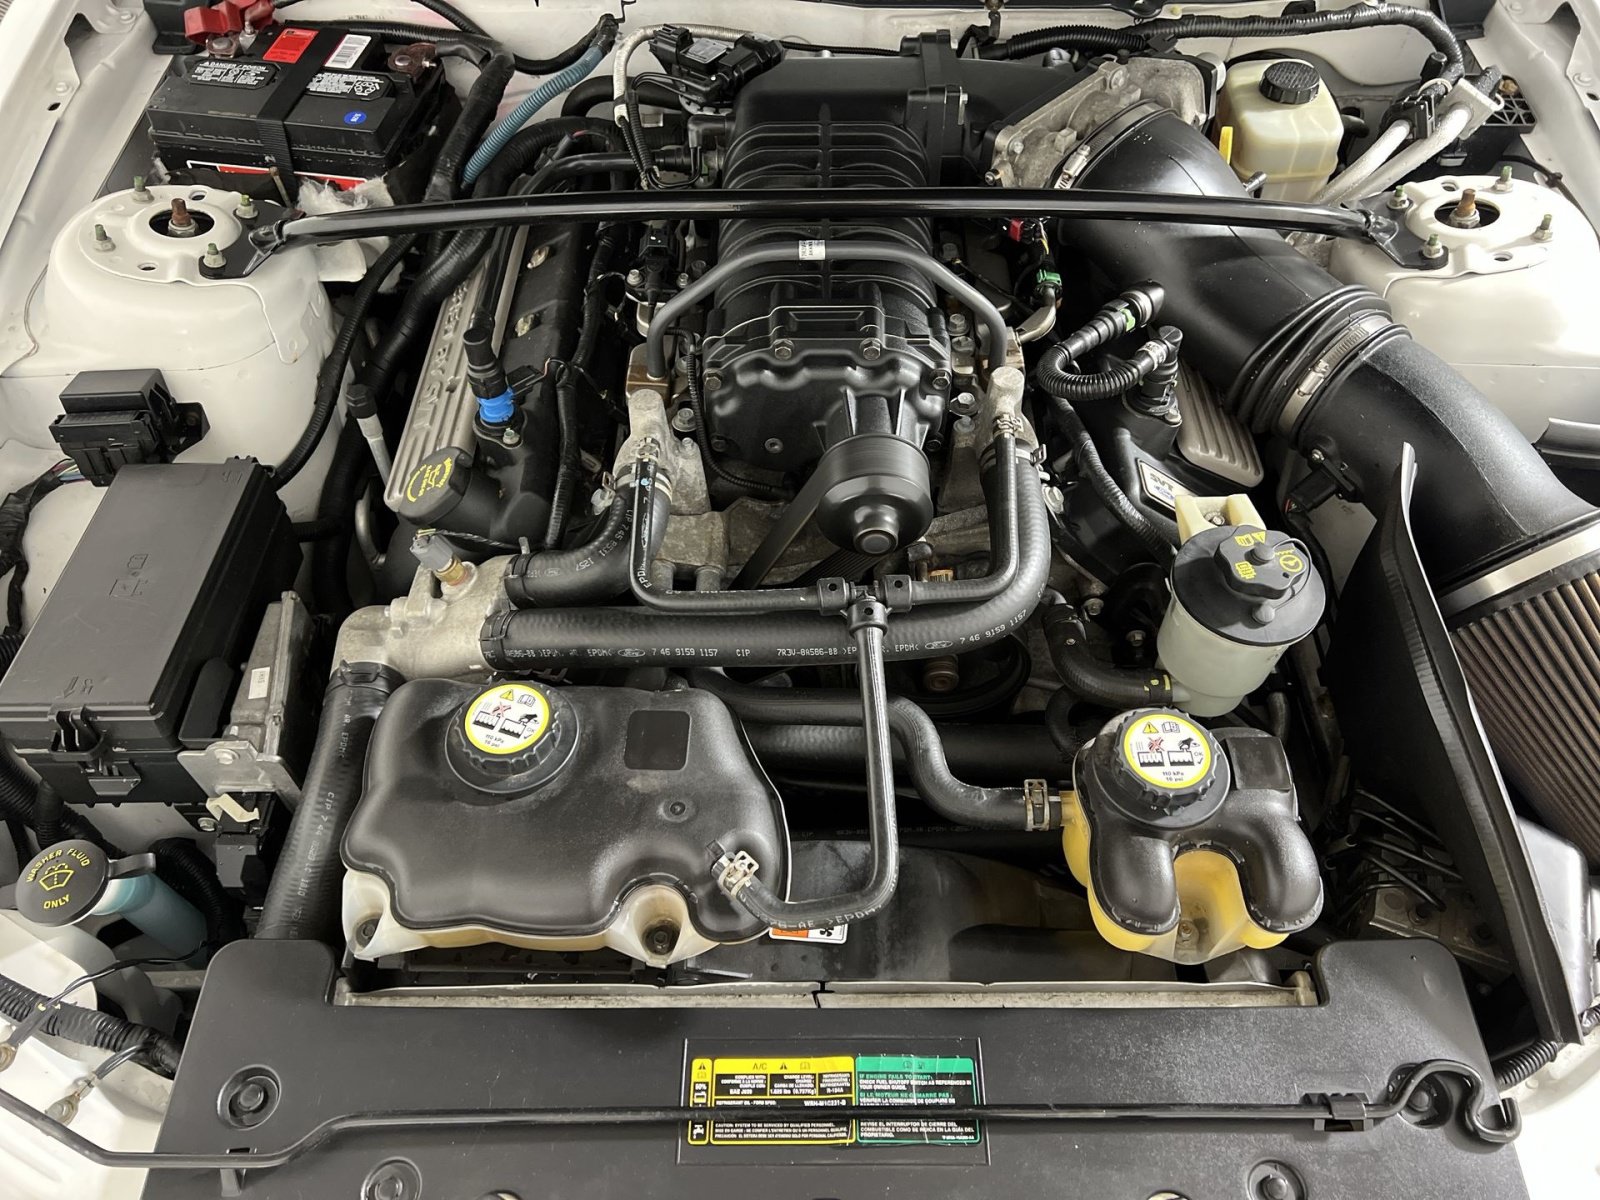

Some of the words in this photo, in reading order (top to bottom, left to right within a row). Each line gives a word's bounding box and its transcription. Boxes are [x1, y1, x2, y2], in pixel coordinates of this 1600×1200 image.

[576, 558, 594, 572] 1257
[969, 634, 981, 642] 46
[985, 624, 1006, 638] 9159
[1009, 609, 1027, 626] 1157
[652, 648, 658, 656] 7
[660, 648, 671, 656] 46
[675, 648, 696, 656] 9159
[700, 648, 718, 657] 1157
[26, 849, 62, 882] WASHER
[66, 848, 91, 868] FLUID
[43, 894, 70, 909] ONLY
